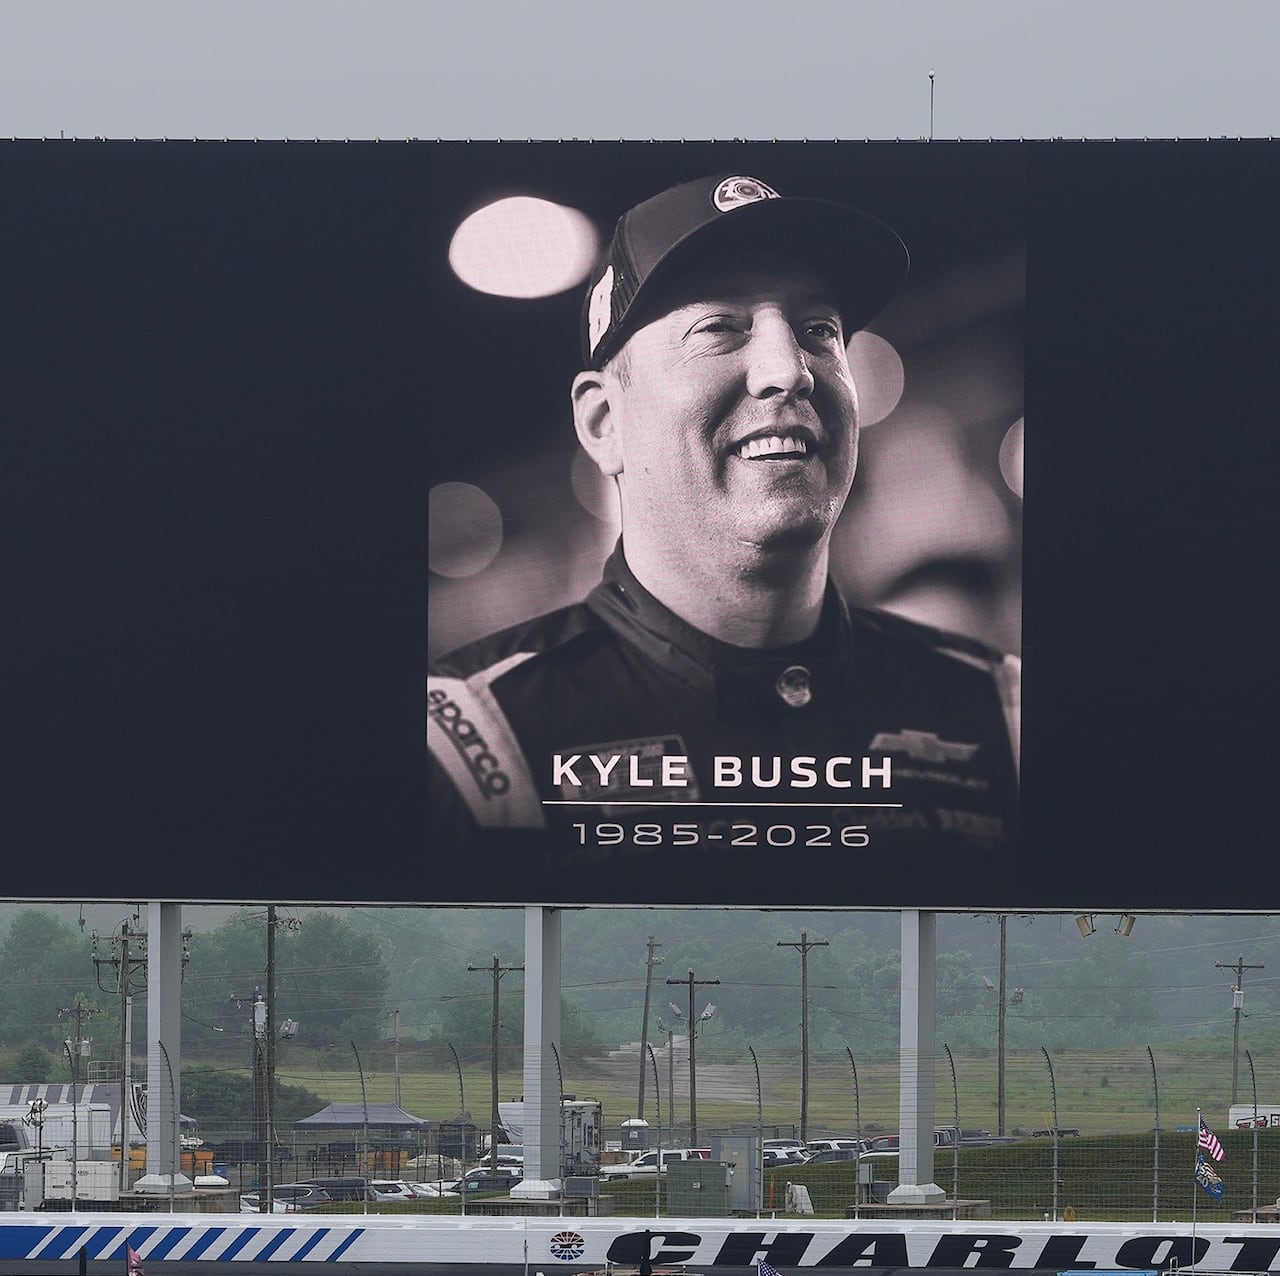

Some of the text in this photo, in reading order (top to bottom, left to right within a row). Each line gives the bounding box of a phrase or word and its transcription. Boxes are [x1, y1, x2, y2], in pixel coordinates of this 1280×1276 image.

[552, 755, 892, 788] KYLE BUSCH
[572, 823, 870, 847] 1985-2026
